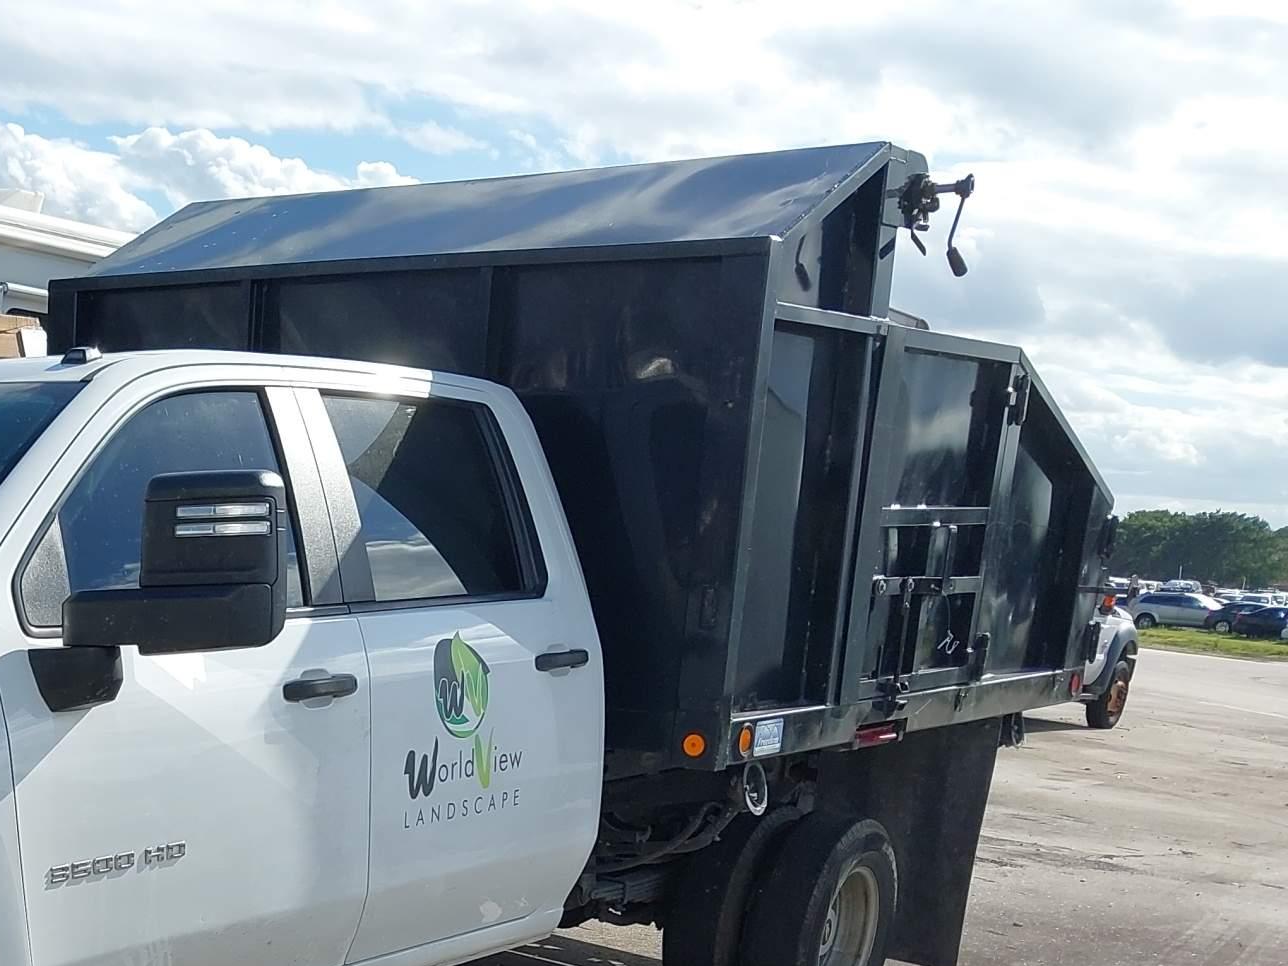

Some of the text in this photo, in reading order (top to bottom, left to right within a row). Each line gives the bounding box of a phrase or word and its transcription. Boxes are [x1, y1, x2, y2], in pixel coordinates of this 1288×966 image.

[404, 727, 523, 800] WorldView
[404, 789, 520, 829] LANDSCAPE
[49, 840, 187, 884] 3500 HD
